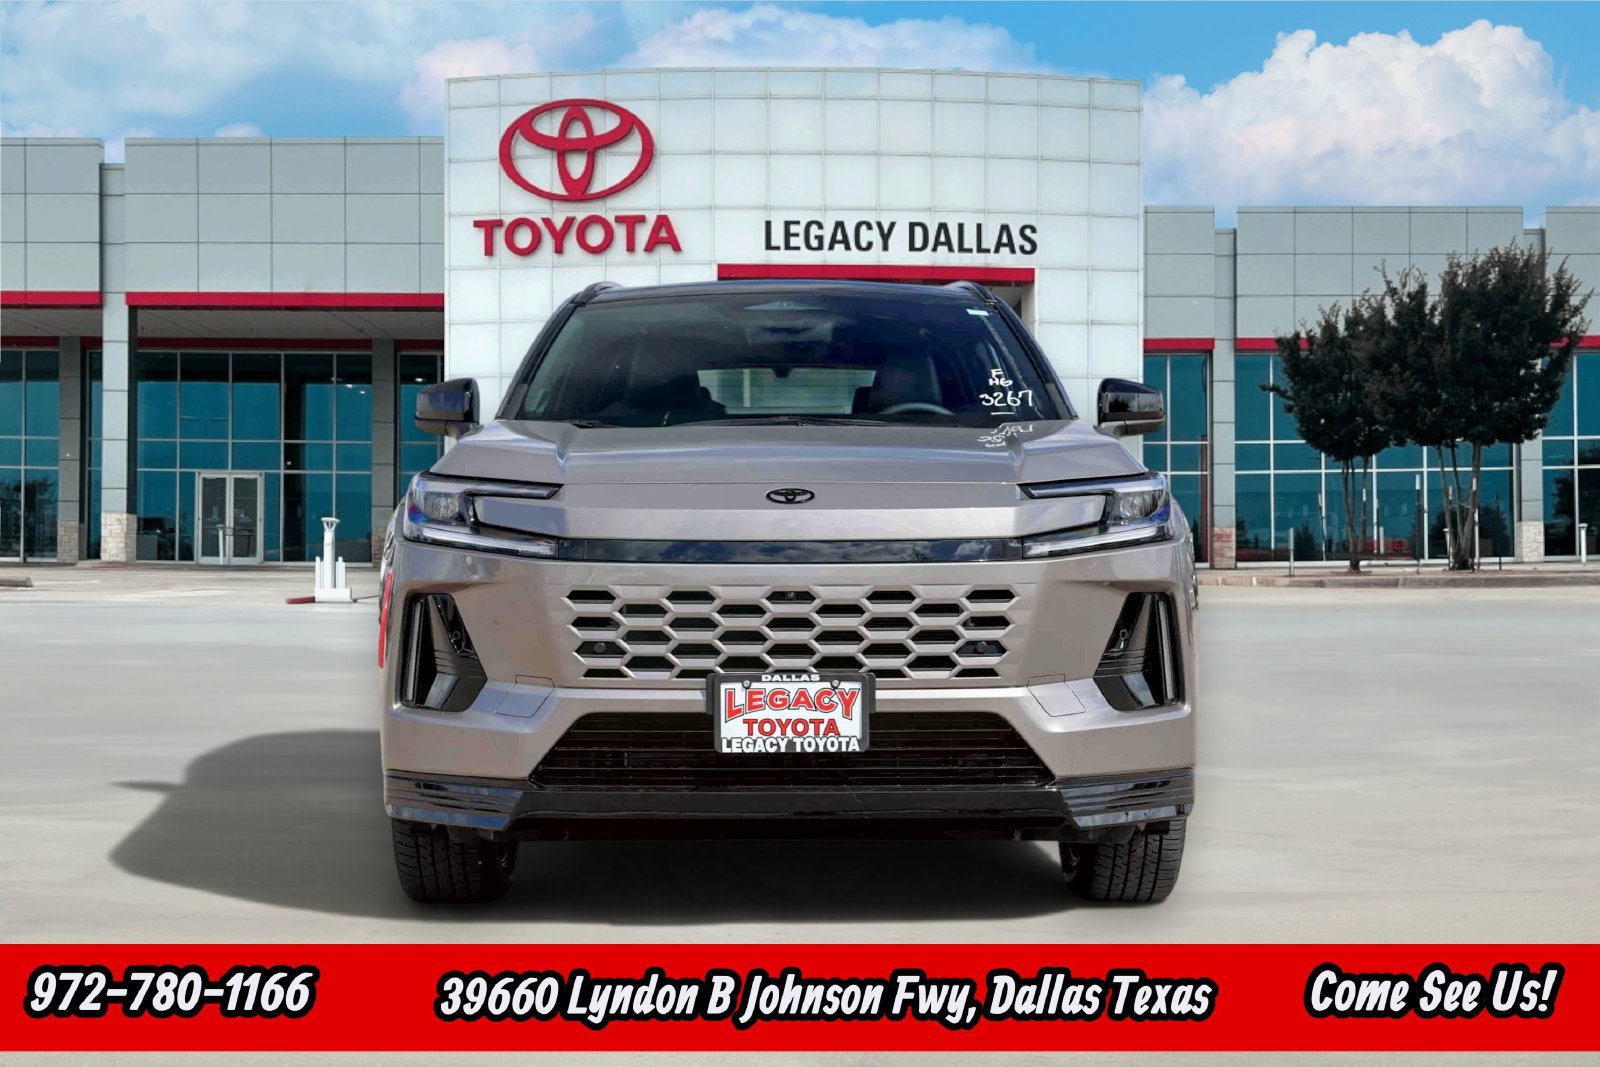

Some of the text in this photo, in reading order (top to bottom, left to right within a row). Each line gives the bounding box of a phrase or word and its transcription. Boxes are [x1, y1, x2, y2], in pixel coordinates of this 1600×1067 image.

[474, 214, 682, 256] TOYOTA
[765, 220, 1038, 255] LEGACY DALLAS
[979, 389, 1033, 407] 3267
[761, 674, 821, 682] DALLAS
[724, 687, 861, 723] LEGACY
[742, 718, 841, 737] TOYOTA
[721, 736, 861, 753] LEGACY TOYOTA
